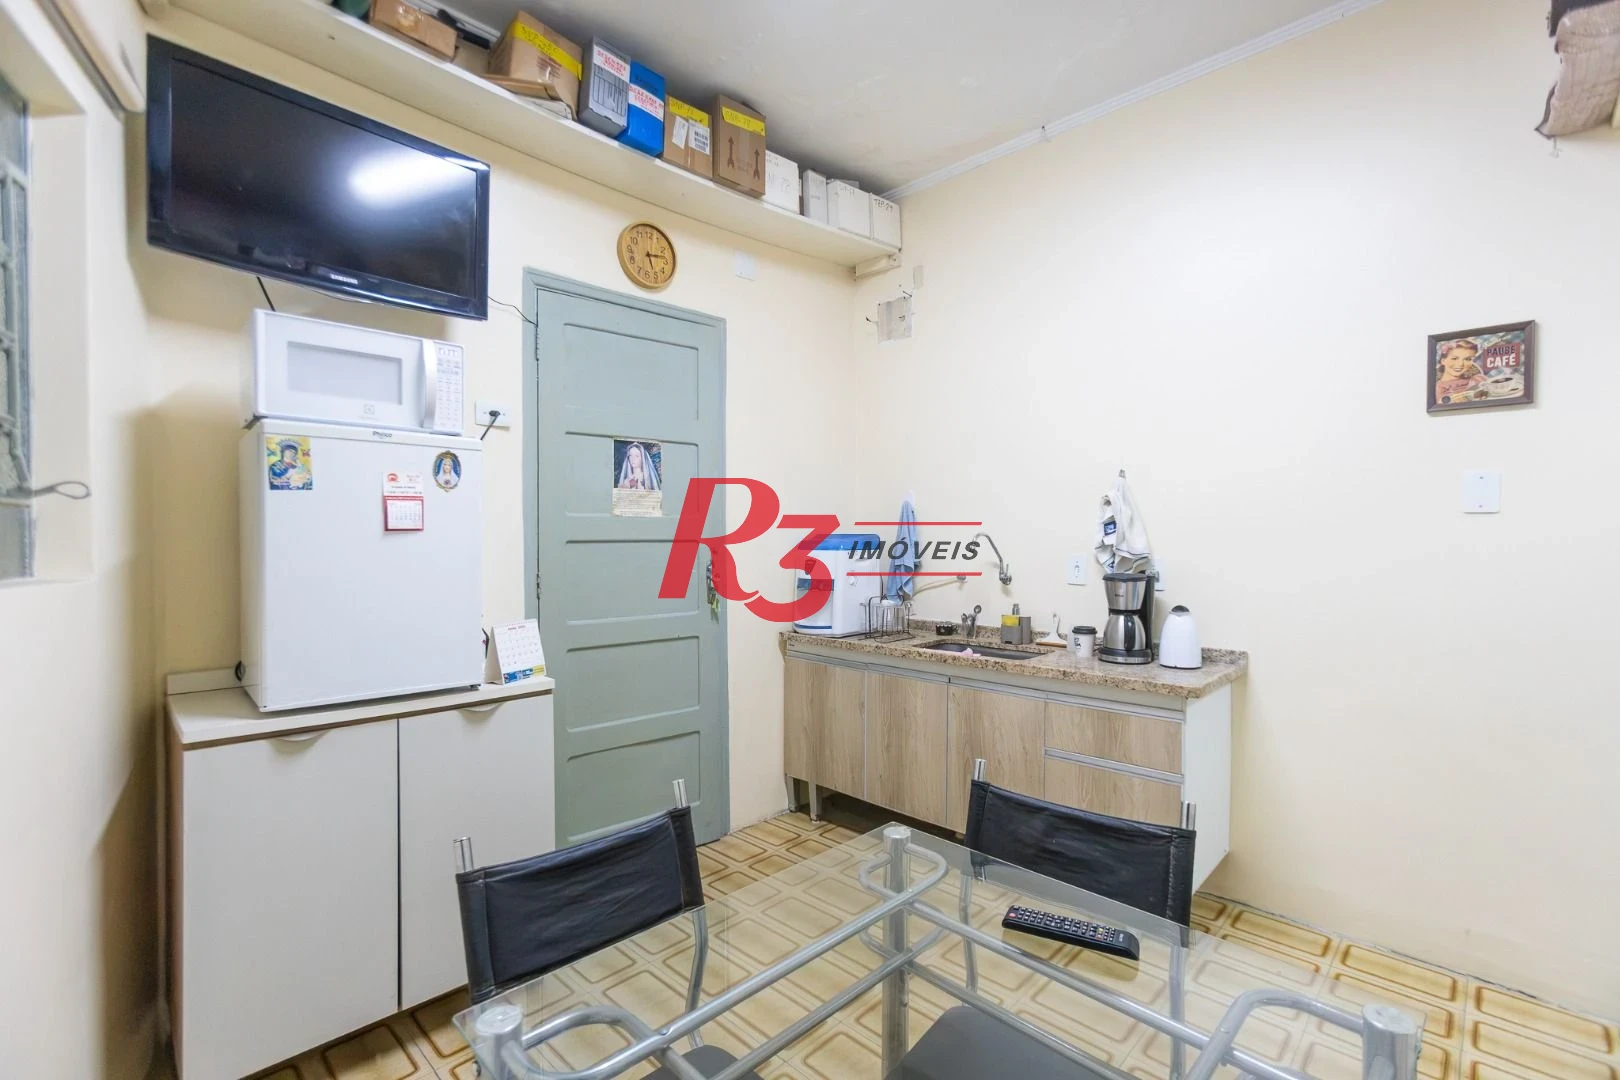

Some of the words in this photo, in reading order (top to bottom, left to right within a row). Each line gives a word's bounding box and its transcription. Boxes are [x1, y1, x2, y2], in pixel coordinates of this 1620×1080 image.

[645, 231, 653, 240] 12
[630, 237, 638, 245] 10
[660, 246, 666, 254] 2
[644, 271, 650, 279] 6
[653, 271, 659, 279] 5
[1486, 353, 1516, 368] CAFÉ
